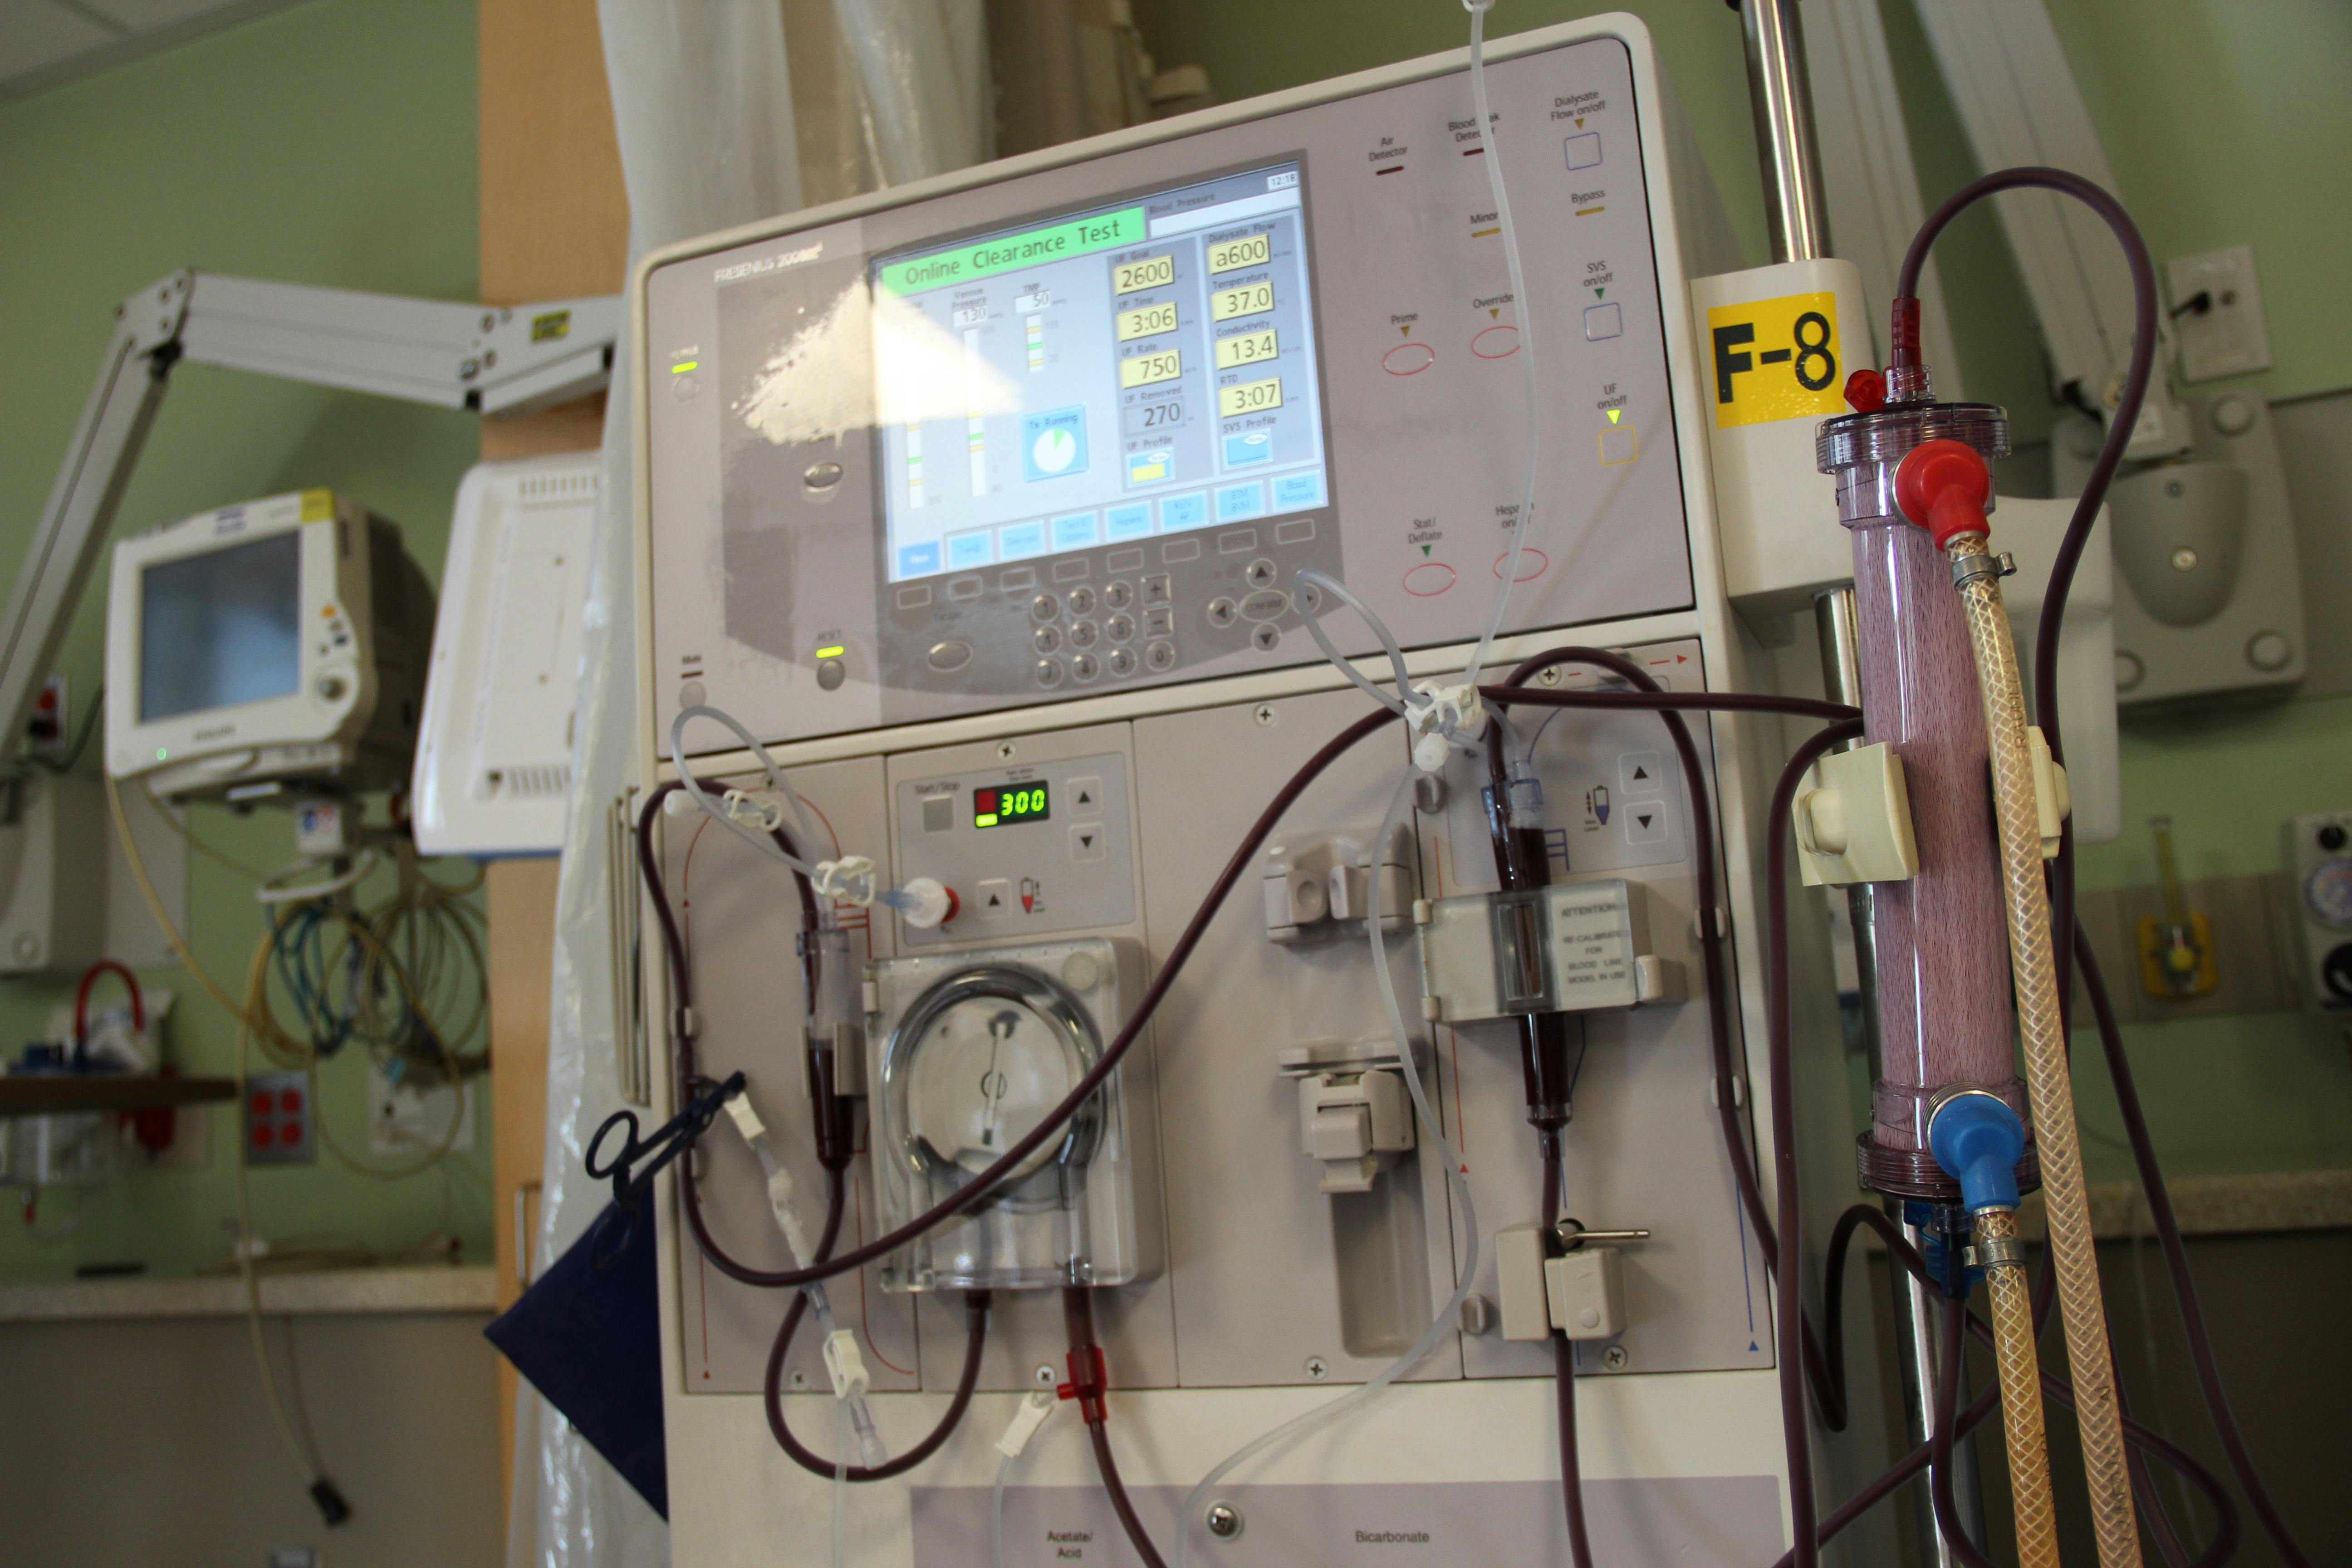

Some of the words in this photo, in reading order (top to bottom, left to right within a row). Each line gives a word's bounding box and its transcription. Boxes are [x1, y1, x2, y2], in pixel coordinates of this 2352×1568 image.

[1554, 90, 1599, 108] Dialysate
[1550, 108, 1575, 121] Flow
[1576, 100, 1606, 117] on/off
[1448, 117, 1475, 132] Blood
[1380, 136, 1394, 147] Air
[1455, 126, 1496, 142] Detecr
[1369, 146, 1407, 162] Detector
[1177, 193, 1216, 207] Pressure
[1571, 189, 1606, 205] Bypass
[1470, 212, 1498, 225] Minor
[1209, 228, 1249, 243] Dialysate
[1254, 221, 1276, 234] Flow
[905, 260, 961, 285] Online
[973, 235, 1066, 270] Clearance
[1079, 219, 1121, 245] Test
[1132, 249, 1150, 261] Goal
[1216, 240, 1266, 267] a600
[715, 258, 774, 283] FRESENIUS
[1587, 260, 1607, 273] SVS
[1122, 261, 1171, 289] 2600
[1213, 272, 1269, 289] Temperature
[1583, 272, 1613, 287] on/off
[1034, 293, 1050, 308] 50
[1135, 296, 1154, 307] Time
[1227, 287, 1270, 313] 37.0
[1473, 293, 1514, 310] Override
[962, 307, 987, 323] 130
[1132, 308, 1175, 333] 3:06
[1391, 312, 1418, 326] Prime
[1217, 320, 1270, 338] Conductivity
[1121, 347, 1133, 357] UF
[1137, 343, 1158, 354] Rate
[1232, 335, 1274, 360] 13.4
[1713, 312, 1836, 404] F-8
[1140, 355, 1177, 380] 750
[1125, 394, 1136, 404] UF
[1141, 386, 1182, 401] Removed
[1235, 383, 1277, 409] 3:07
[1603, 383, 1617, 395] UF
[1597, 394, 1628, 410] on/off
[1028, 419, 1041, 431] Tx
[1044, 412, 1078, 428] Running
[1144, 402, 1181, 427] 270
[1223, 422, 1242, 433] SVS
[1246, 416, 1277, 429] Profile
[1127, 441, 1138, 451] UF
[1142, 436, 1173, 448] Profile
[1413, 516, 1437, 529] Stat/
[1407, 529, 1443, 544] Deflate
[1001, 789, 1045, 816] 300
[1047, 1529, 1094, 1542] Acetate/
[1355, 1530, 1430, 1543] Bicarbonate
[1058, 1546, 1082, 1558] Acid
